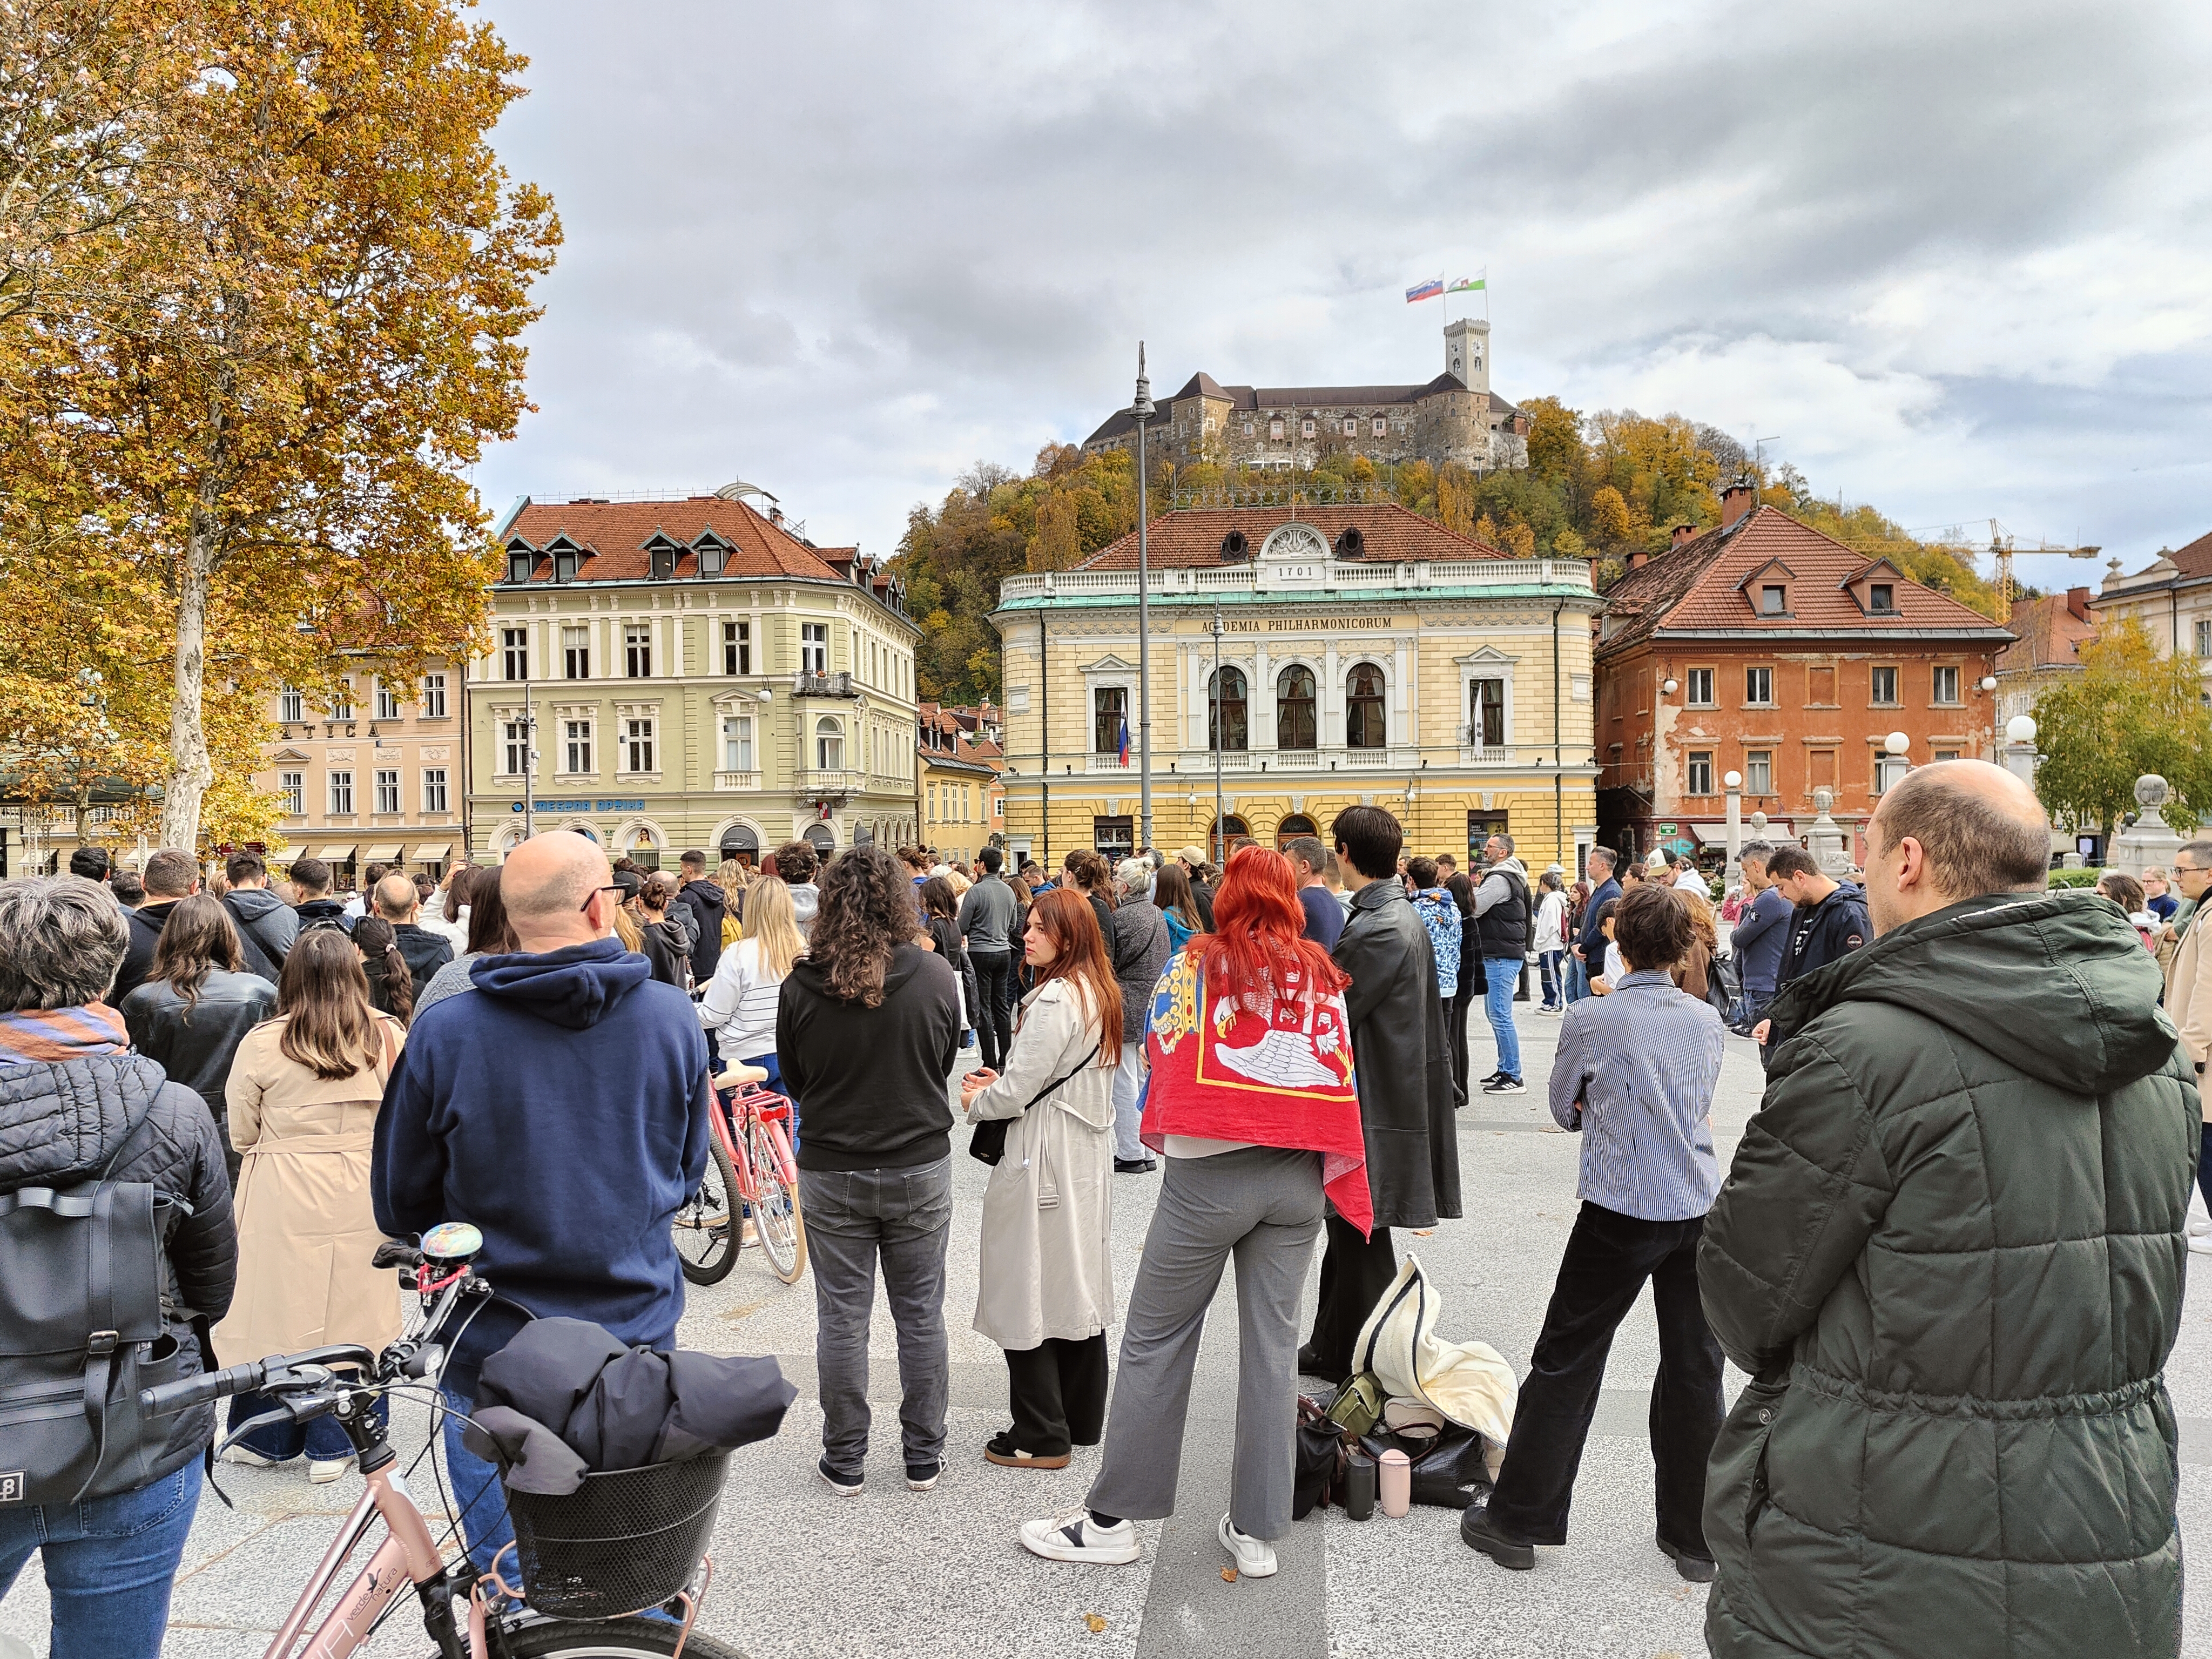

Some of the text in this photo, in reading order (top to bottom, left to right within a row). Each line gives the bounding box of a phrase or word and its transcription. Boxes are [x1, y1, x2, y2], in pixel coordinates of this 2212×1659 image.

[1279, 567, 1312, 576] 1701
[1202, 617, 1392, 632] ACDEMIA PHILHARMONICORUM
[535, 800, 645, 812] MESTNA OPTIKA
[371, 1567, 397, 1602] natura
[347, 1593, 369, 1621] verde
